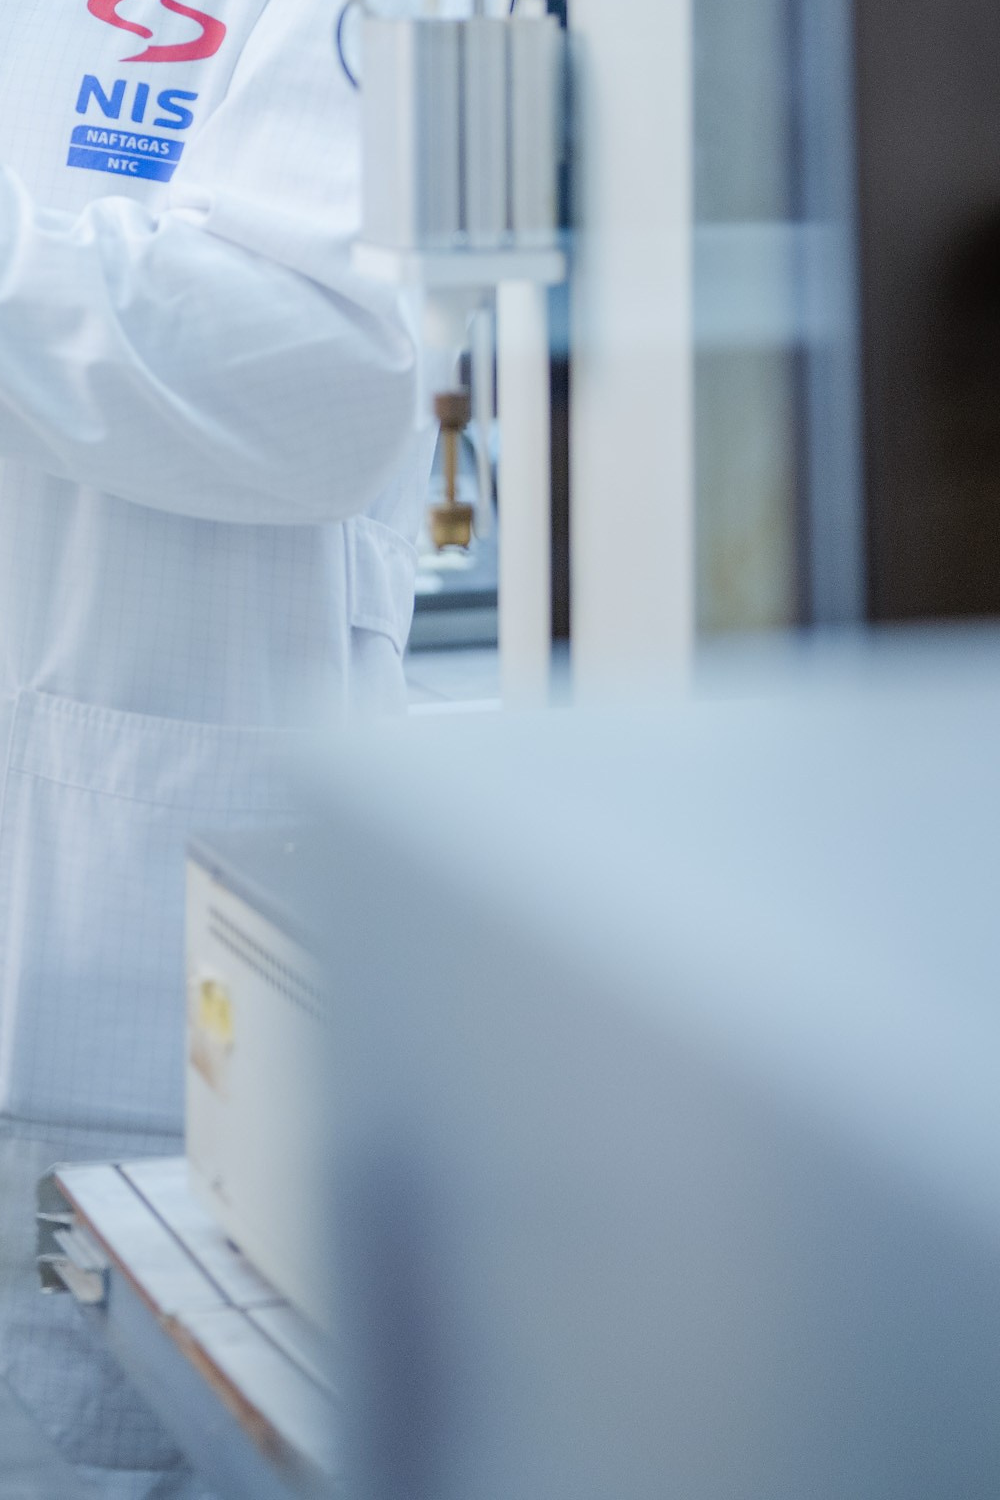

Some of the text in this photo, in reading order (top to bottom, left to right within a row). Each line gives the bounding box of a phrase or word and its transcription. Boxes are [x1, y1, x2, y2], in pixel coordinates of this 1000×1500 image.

[75, 74, 198, 129] NIS
[87, 130, 169, 155] NAFTAGAS
[107, 157, 138, 173] NTC
